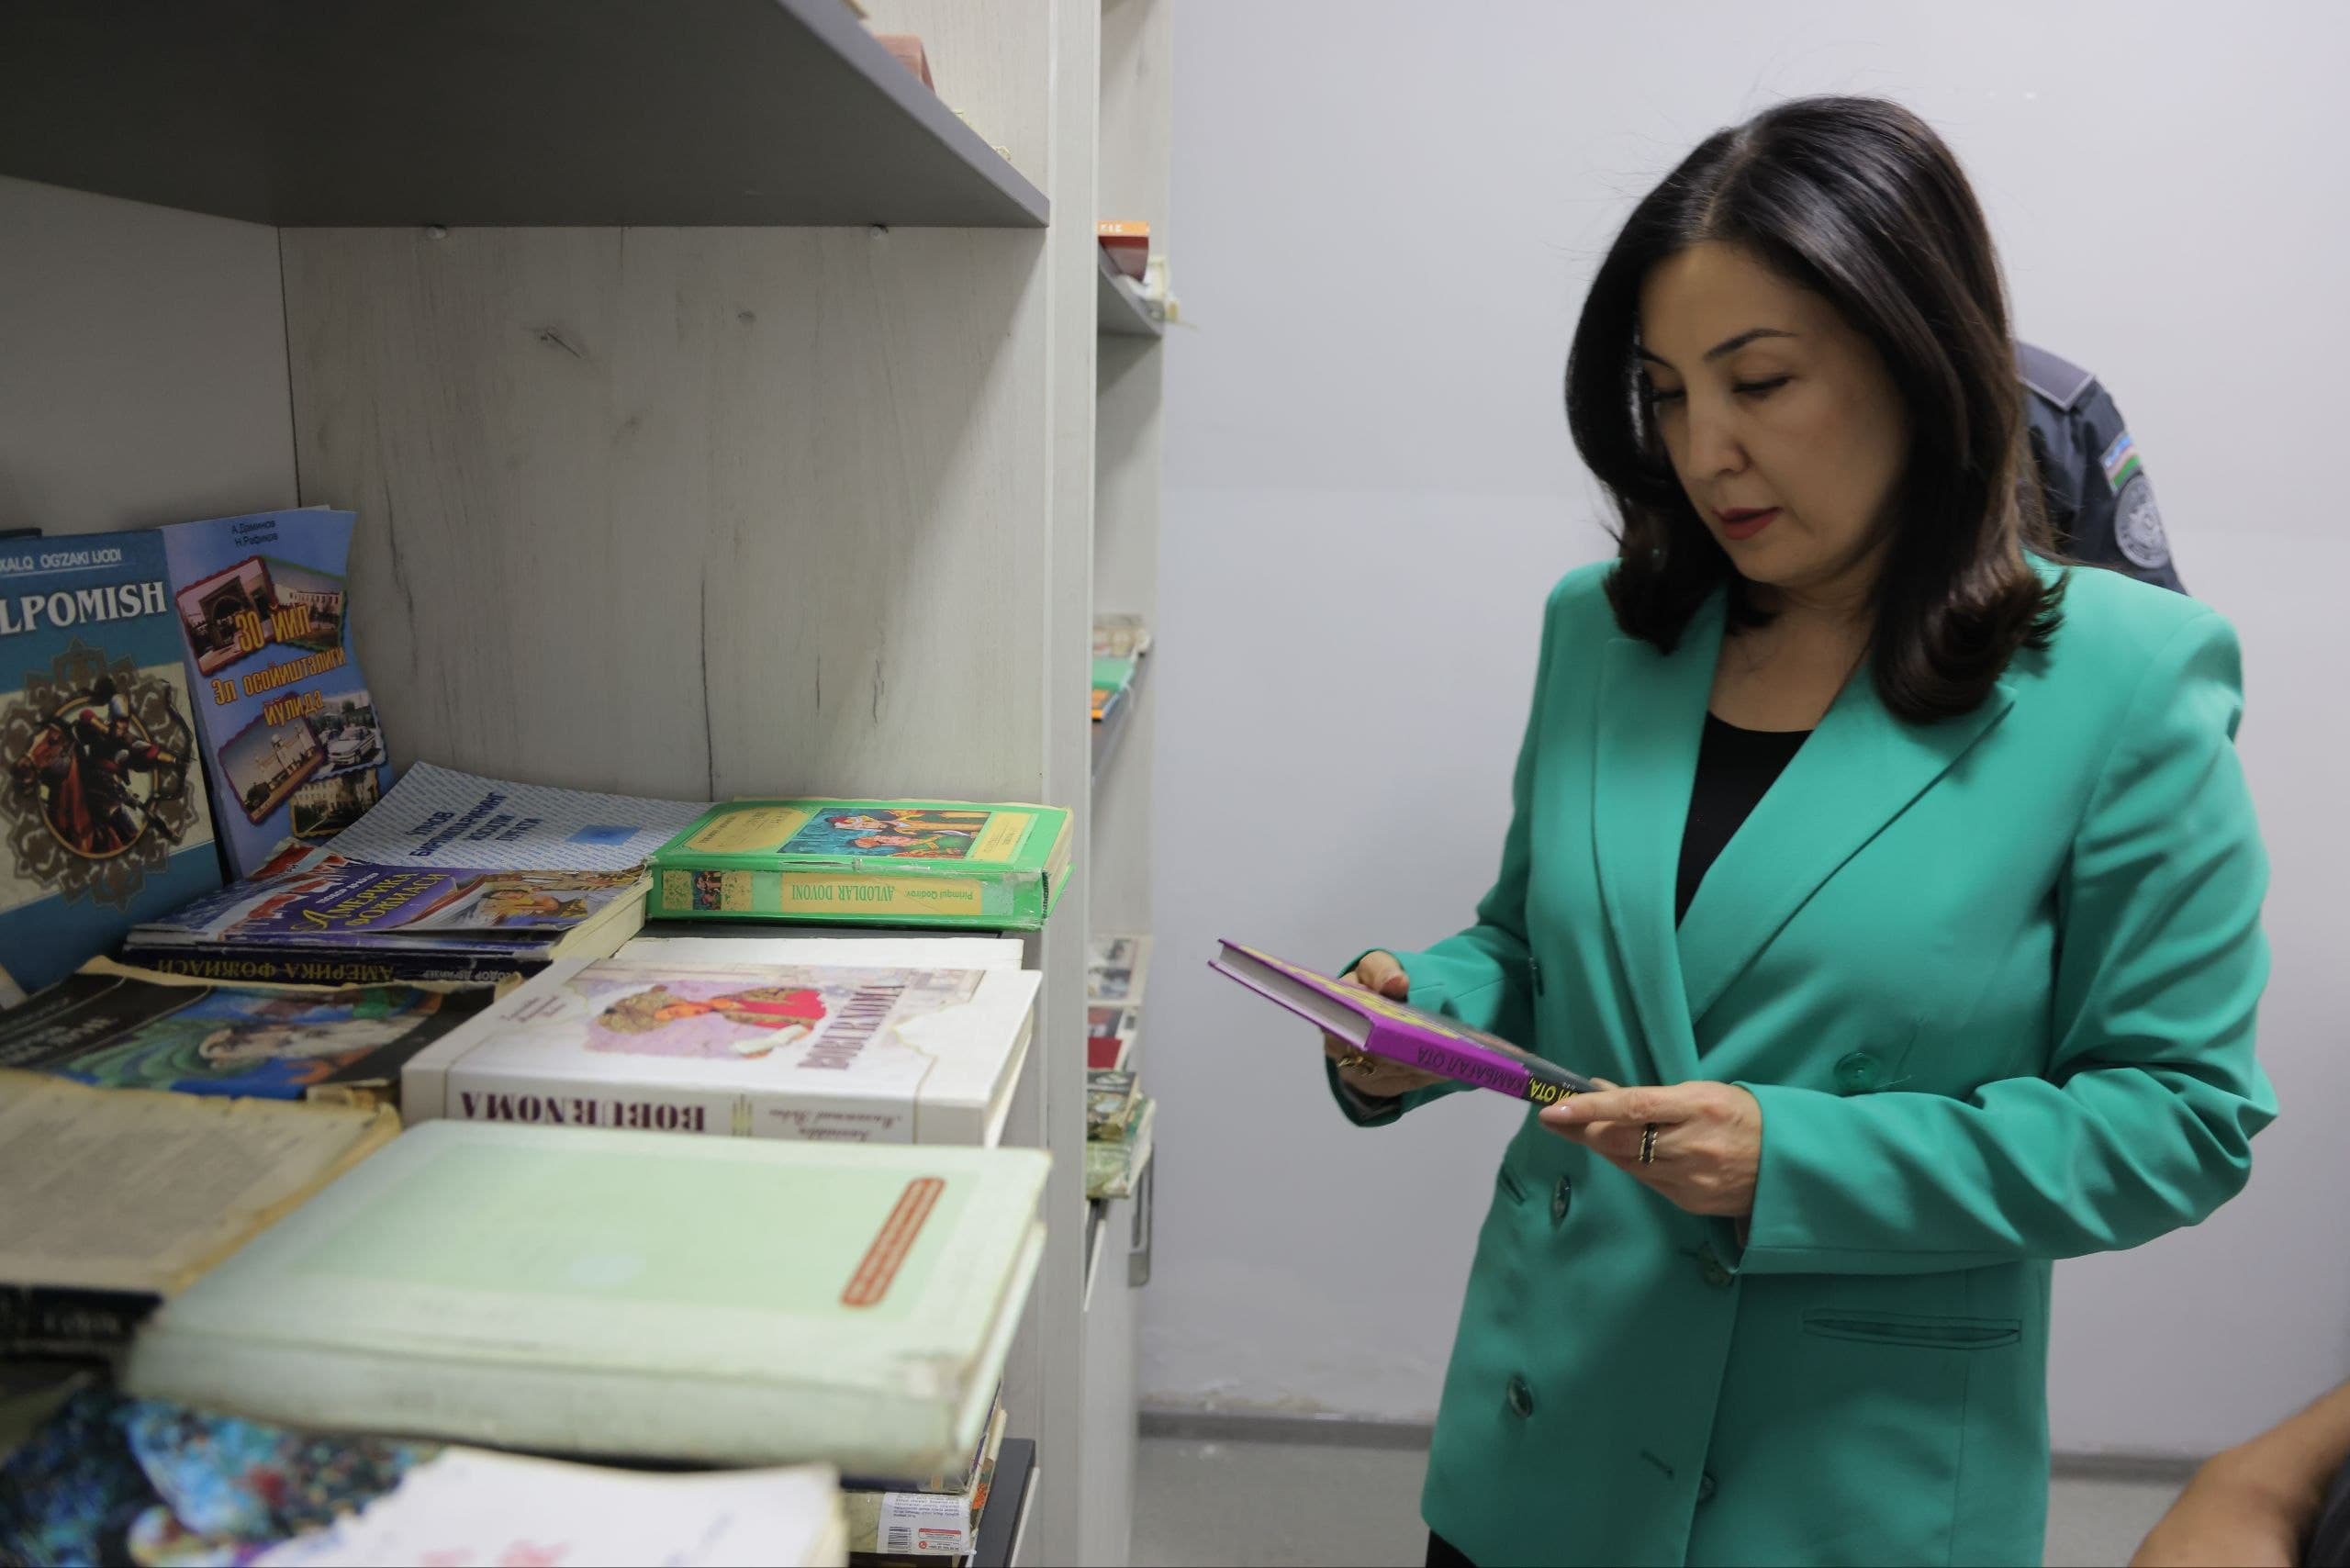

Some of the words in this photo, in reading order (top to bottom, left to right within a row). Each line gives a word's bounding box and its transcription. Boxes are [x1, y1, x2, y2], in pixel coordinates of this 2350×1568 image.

[235, 610, 265, 652] 30
[791, 883, 833, 901] DOVONI
[837, 883, 896, 902] AVLODLAR
[284, 961, 395, 981] АМЕРИКА
[460, 1092, 706, 1132] BOBURNOMA
